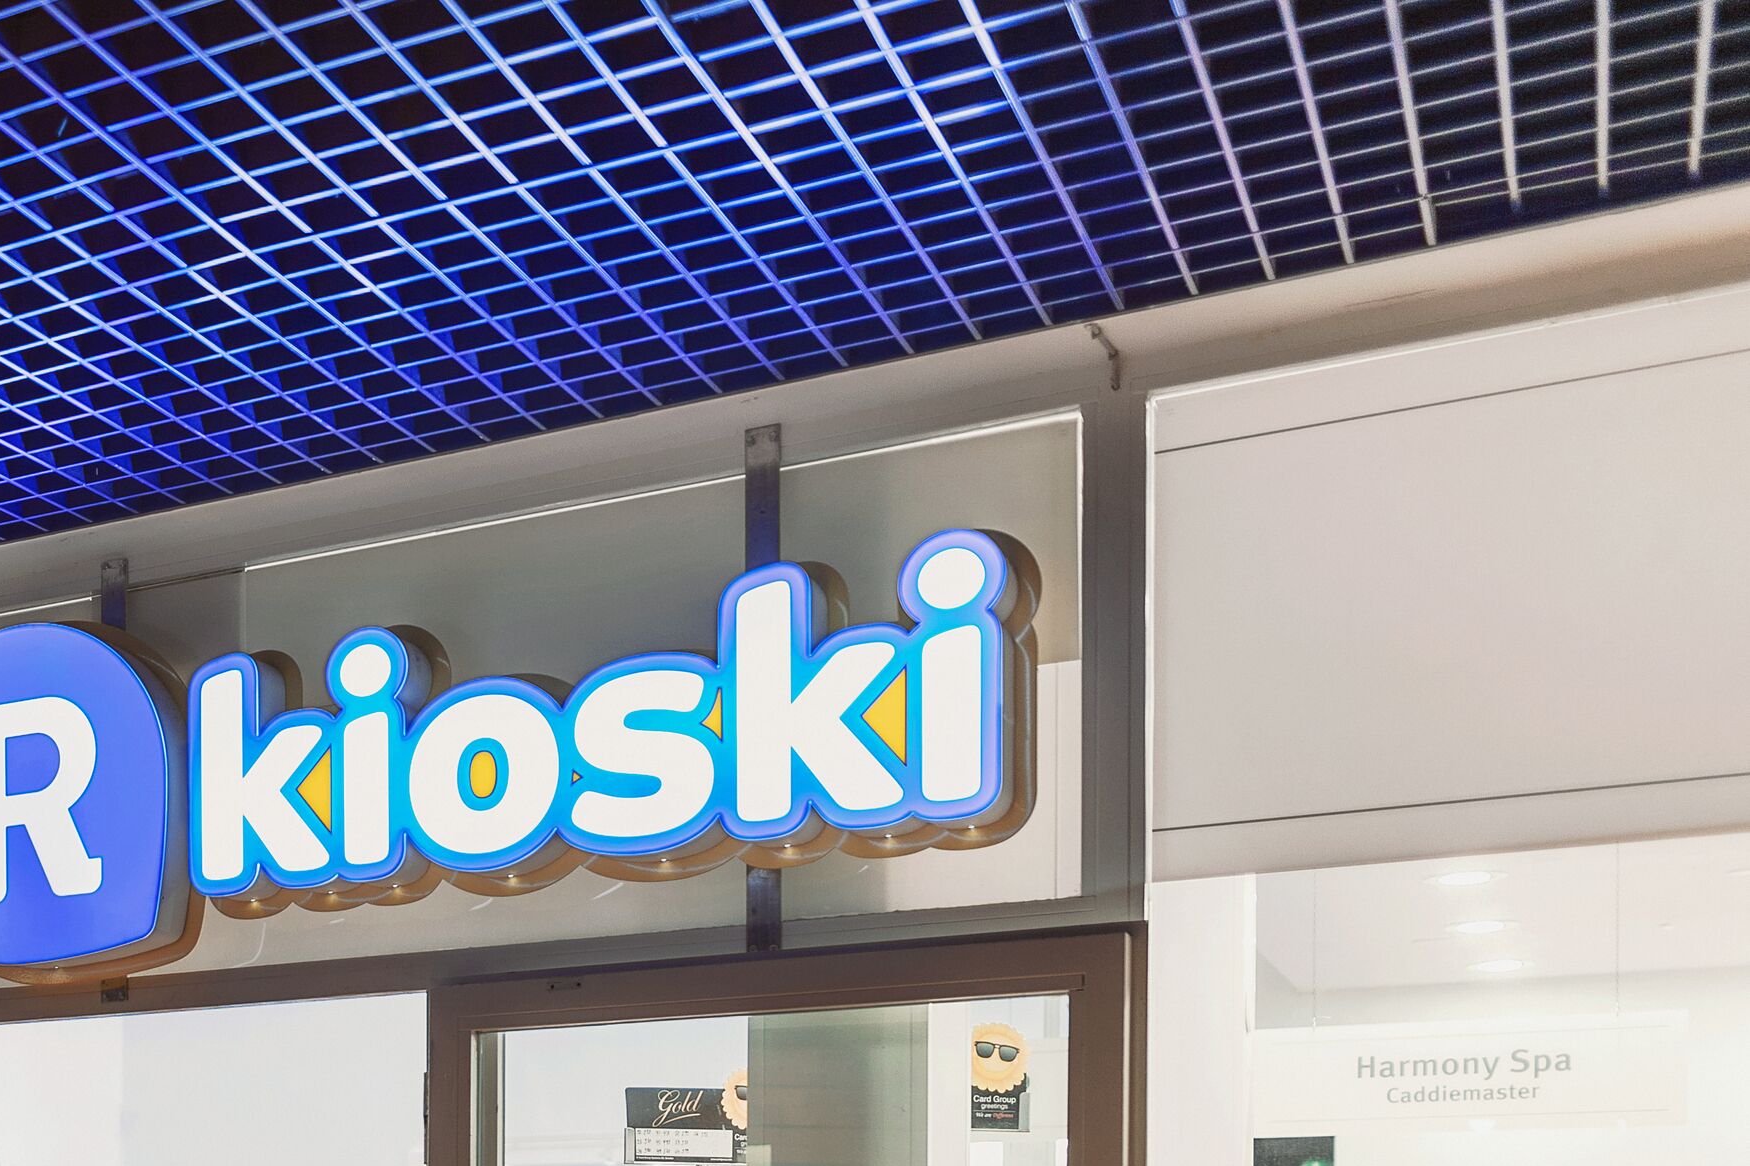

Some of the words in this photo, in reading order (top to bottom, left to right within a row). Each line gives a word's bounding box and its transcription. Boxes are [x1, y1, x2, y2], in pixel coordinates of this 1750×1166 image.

[198, 546, 988, 884] kioski
[1357, 1055, 1501, 1081] Harmony
[1509, 1048, 1573, 1079] Spa
[652, 1089, 704, 1127] Gold
[972, 1094, 992, 1103] Card
[993, 1095, 1017, 1104] Group
[1386, 1084, 1540, 1104] Caddiemaster
